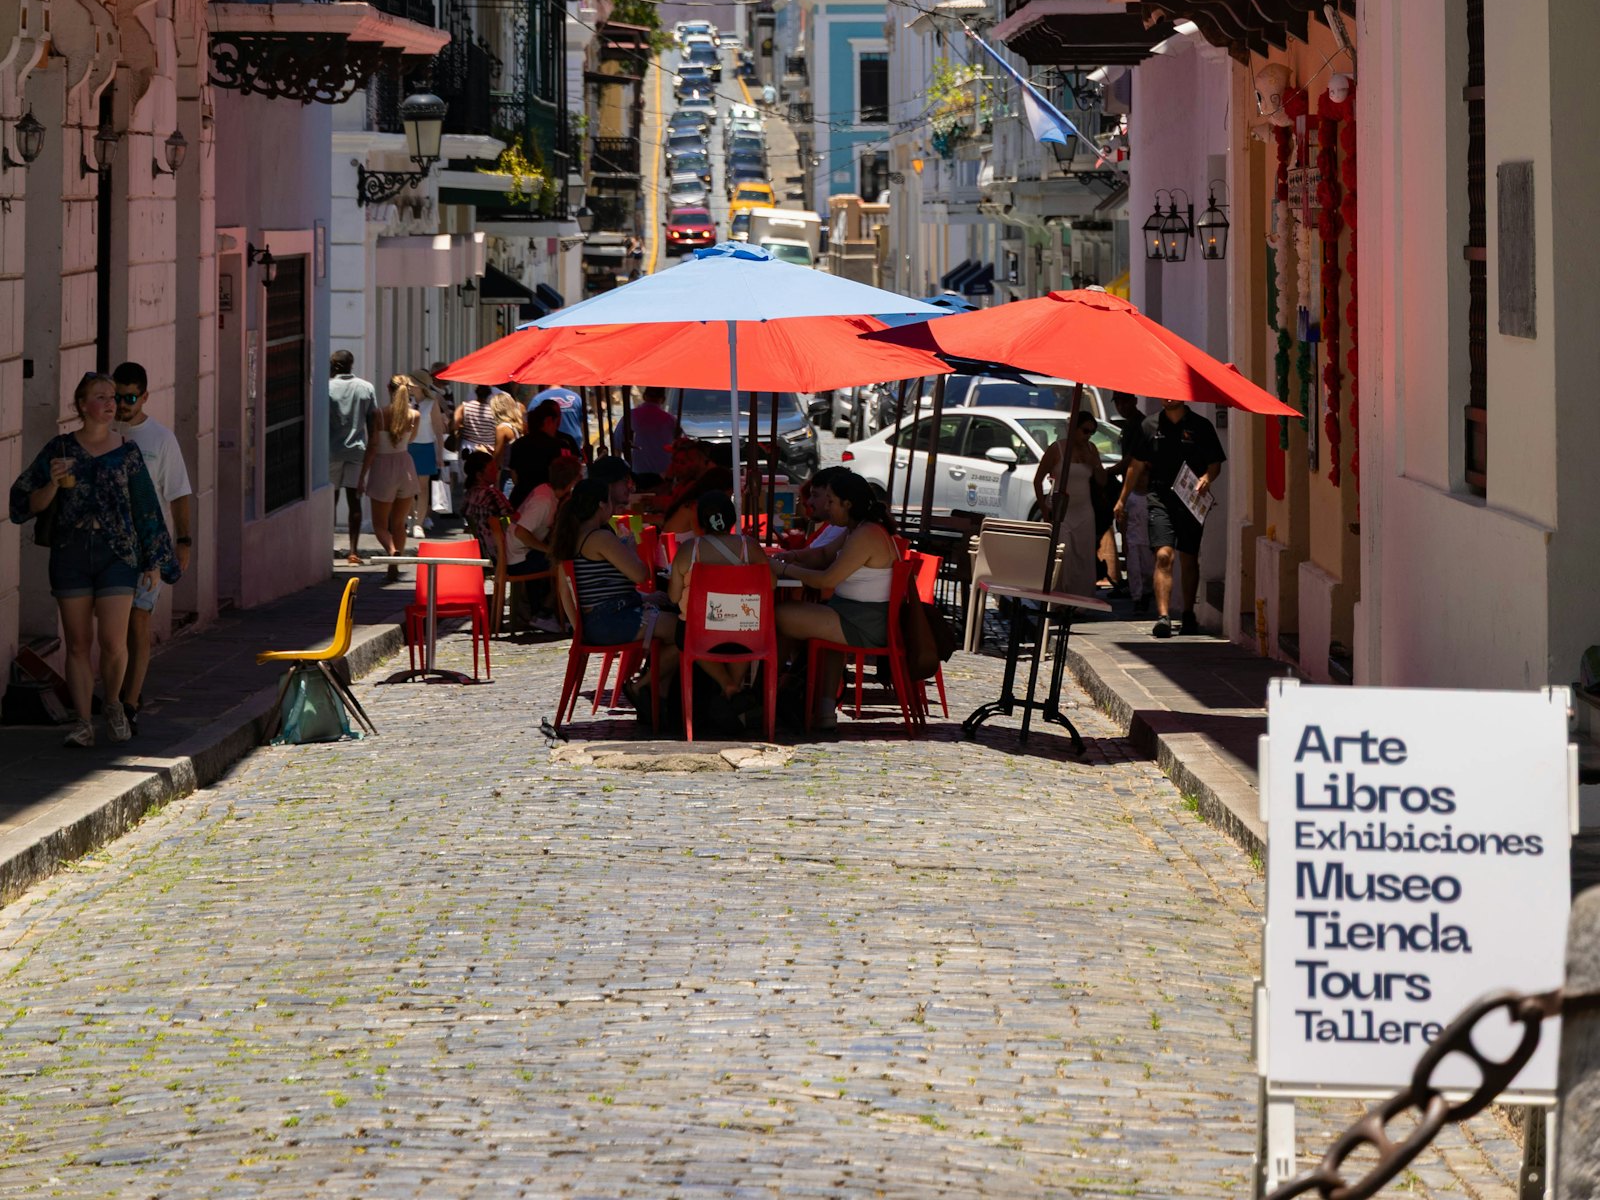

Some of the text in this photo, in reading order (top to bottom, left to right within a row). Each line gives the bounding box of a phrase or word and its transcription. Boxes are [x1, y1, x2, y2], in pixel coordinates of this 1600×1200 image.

[1294, 725, 1407, 765] Arte
[1295, 772, 1456, 814] Libros
[1295, 821, 1544, 856] Exhibiciones
[1296, 861, 1462, 903] Museo
[1295, 910, 1472, 953] Tienda
[1295, 960, 1431, 1001] Tours
[1295, 1009, 1448, 1045] Tallere
